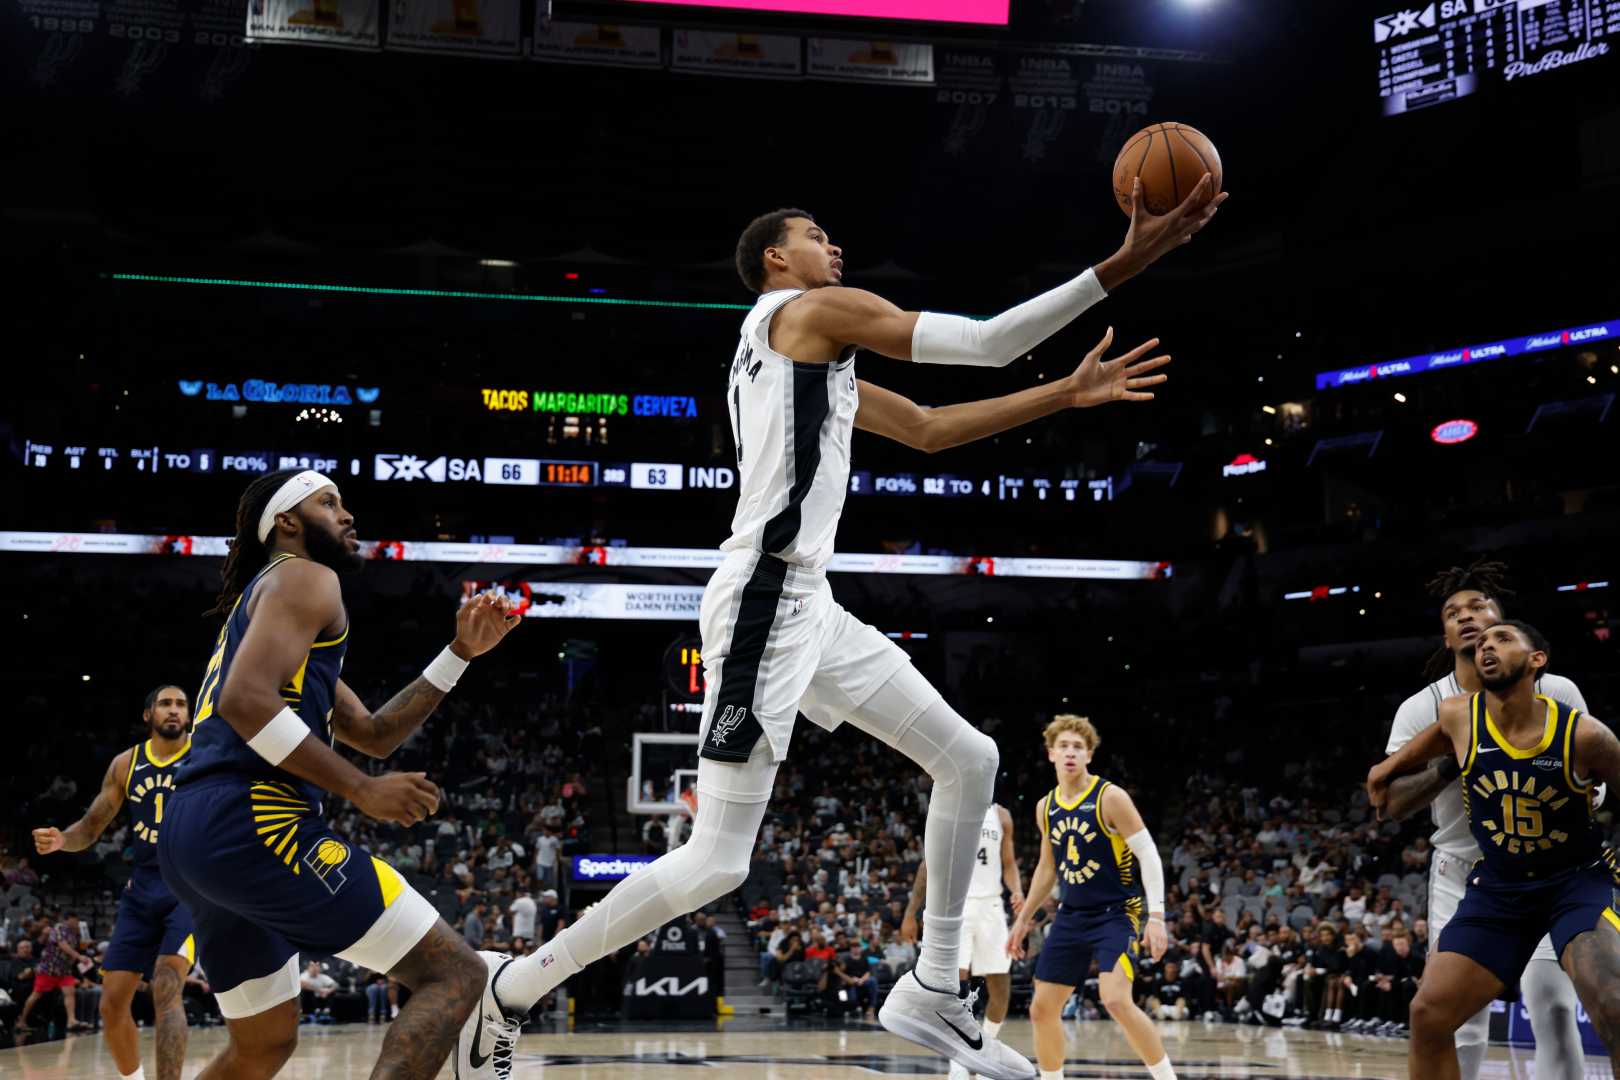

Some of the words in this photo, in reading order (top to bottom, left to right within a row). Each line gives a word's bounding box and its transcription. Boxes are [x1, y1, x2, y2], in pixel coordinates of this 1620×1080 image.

[1440, 0, 1468, 18] SA
[29, 15, 95, 32] 1999
[249, 23, 275, 32] SAN
[108, 22, 180, 43] 2003
[194, 31, 243, 46] 200
[1503, 41, 1609, 81] ProBaller
[937, 91, 998, 105] 2007
[1015, 95, 1078, 110] 2013
[1088, 99, 1148, 115] 2014
[1570, 326, 1608, 341] ULTRA
[1470, 345, 1506, 359] ULTRA
[1377, 361, 1411, 376] ULTRA
[482, 389, 528, 411] TACOS
[533, 391, 629, 415] MARGARITAS
[164, 454, 191, 469] TO
[222, 456, 268, 472] FG%
[313, 459, 338, 474] PF
[448, 457, 482, 482] SA
[502, 463, 522, 481] 66
[547, 463, 580, 483] 11:14
[649, 468, 668, 486] 63
[688, 466, 735, 489] IND
[875, 477, 917, 492] FG%
[949, 479, 973, 494] TO
[626, 592, 671, 602] WORTH
[674, 593, 704, 602] EVER
[625, 602, 662, 611] DAMN
[1472, 769, 1569, 811] INDIANA
[1500, 793, 1544, 837] 15
[1050, 816, 1097, 845] INDIANA
[1482, 819, 1569, 855] PACERS
[1066, 834, 1080, 865] 4
[635, 976, 709, 996] KIA
